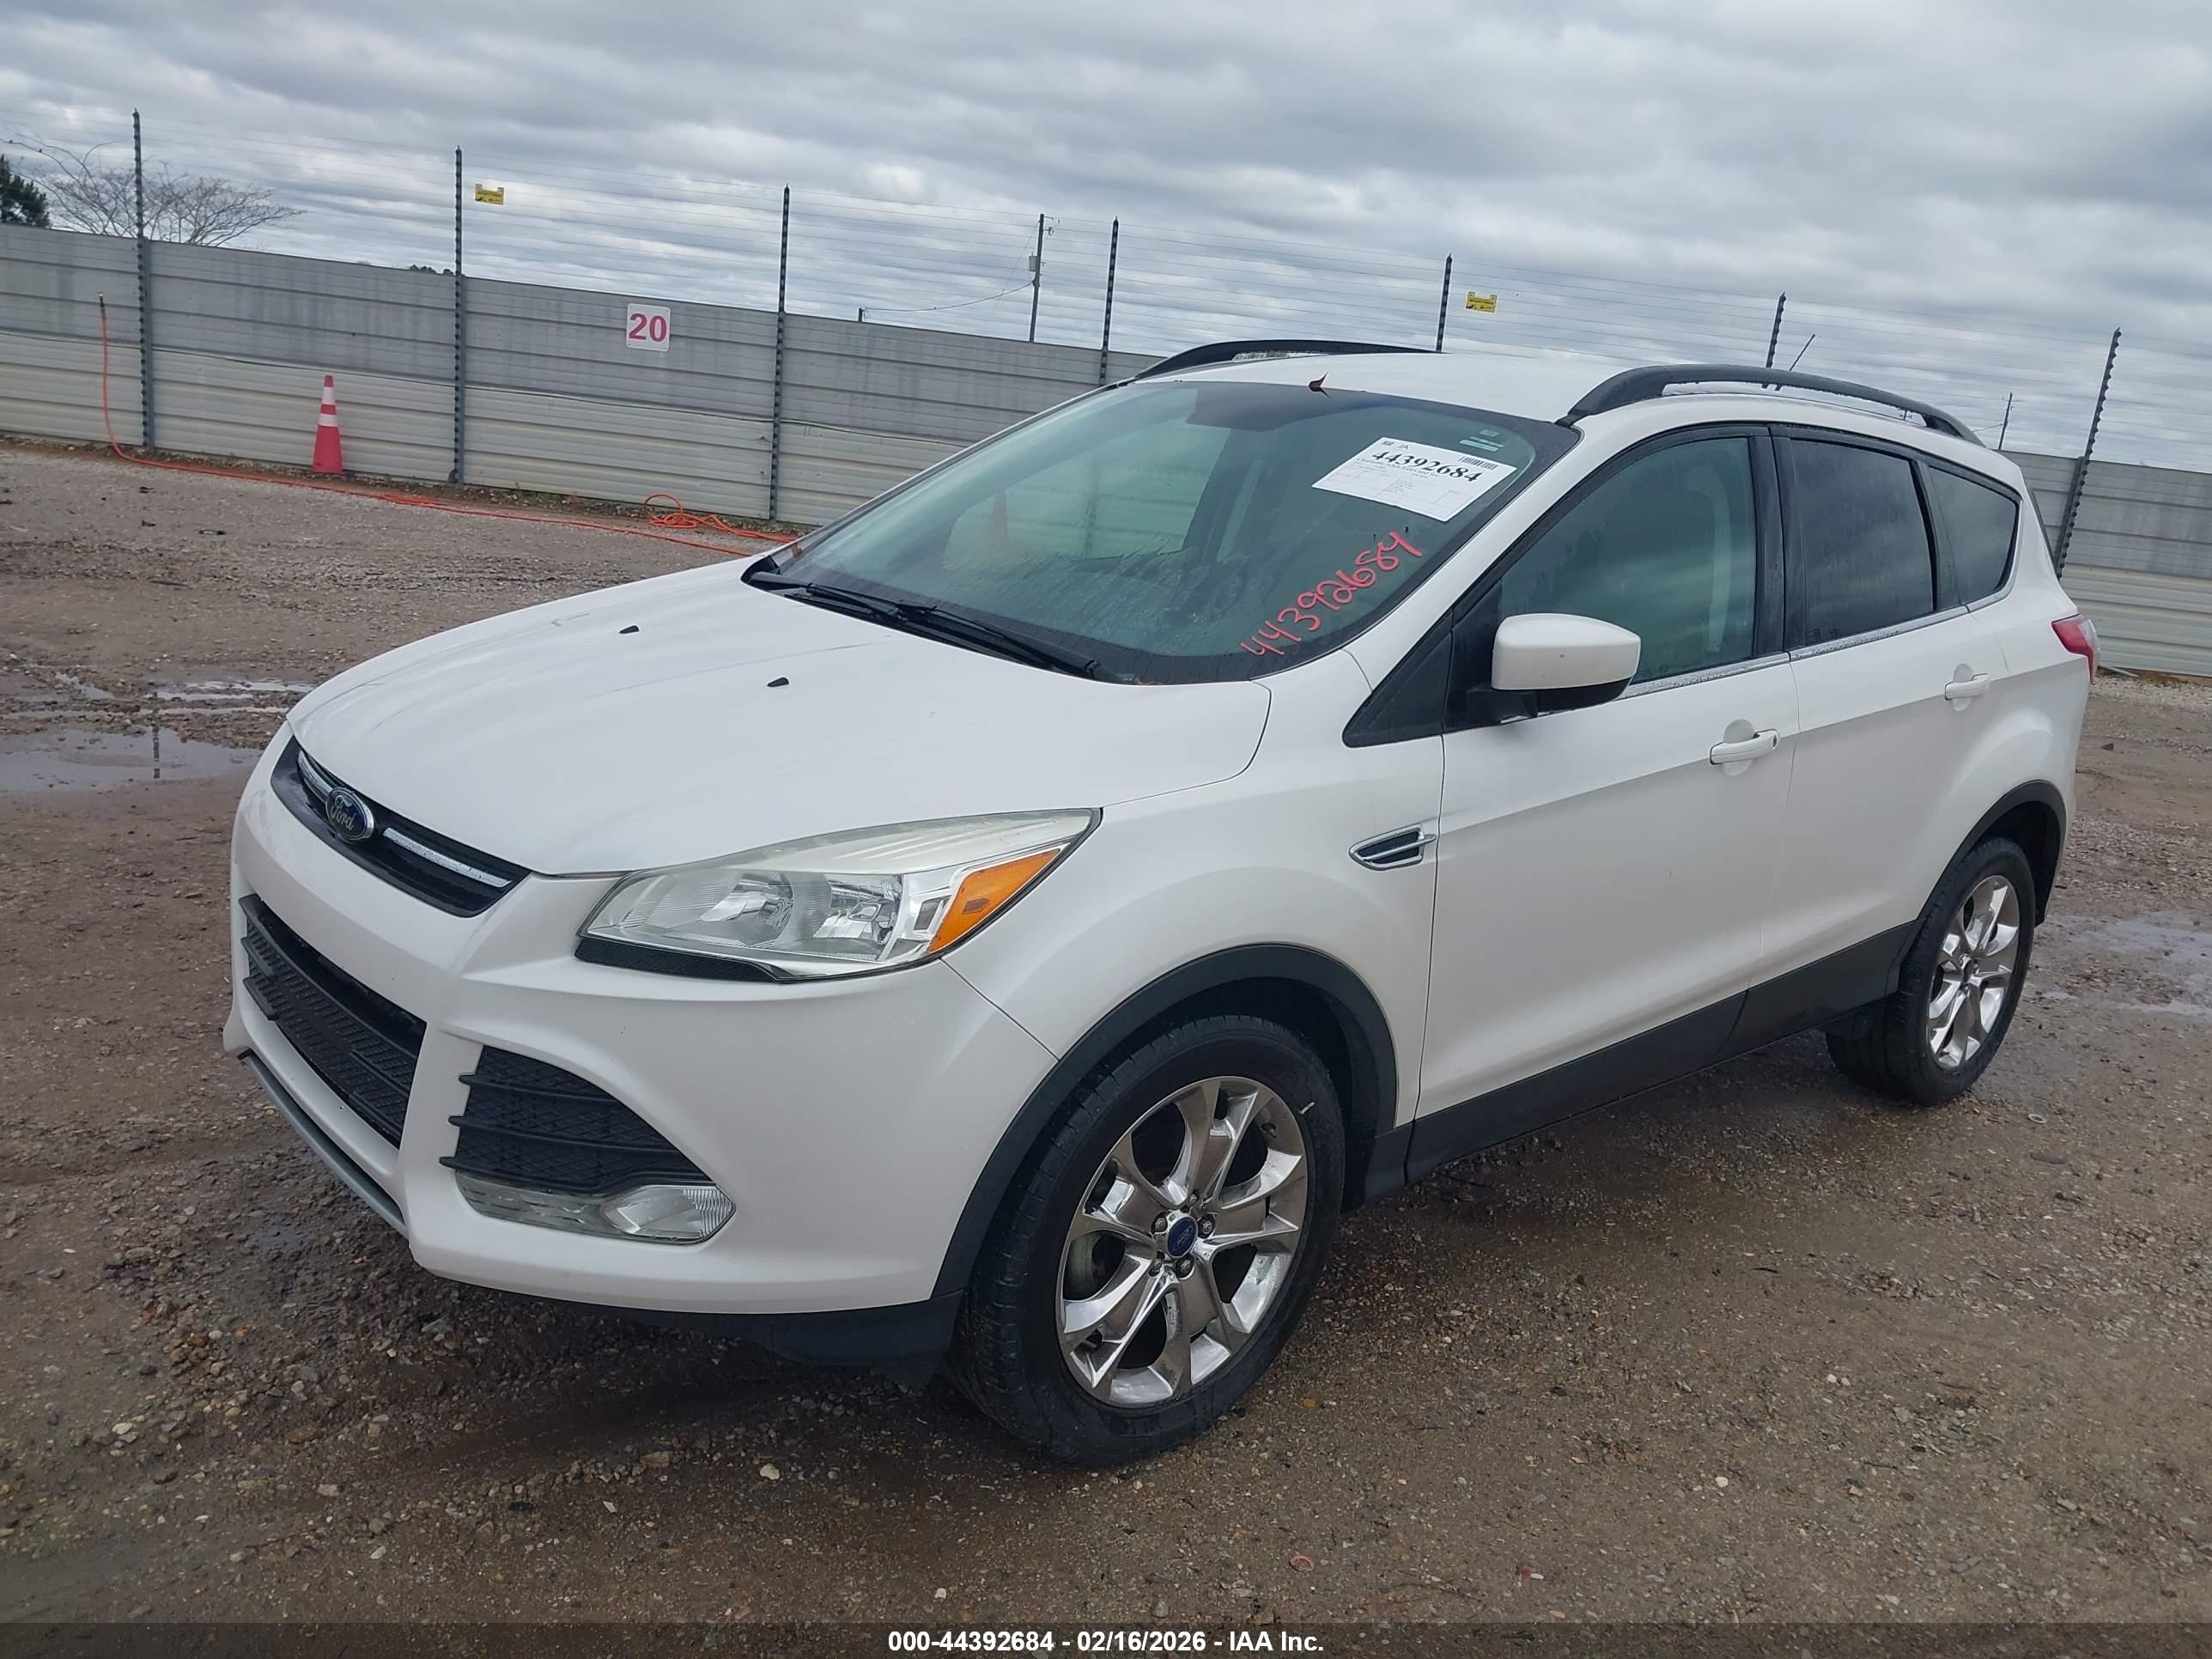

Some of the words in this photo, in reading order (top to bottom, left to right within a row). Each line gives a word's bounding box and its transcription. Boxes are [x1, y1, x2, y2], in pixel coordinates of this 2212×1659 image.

[629, 313, 667, 343] 20
[1372, 451, 1483, 482] 44392684
[1240, 532, 1422, 655] 44392684
[331, 795, 357, 830] Ford
